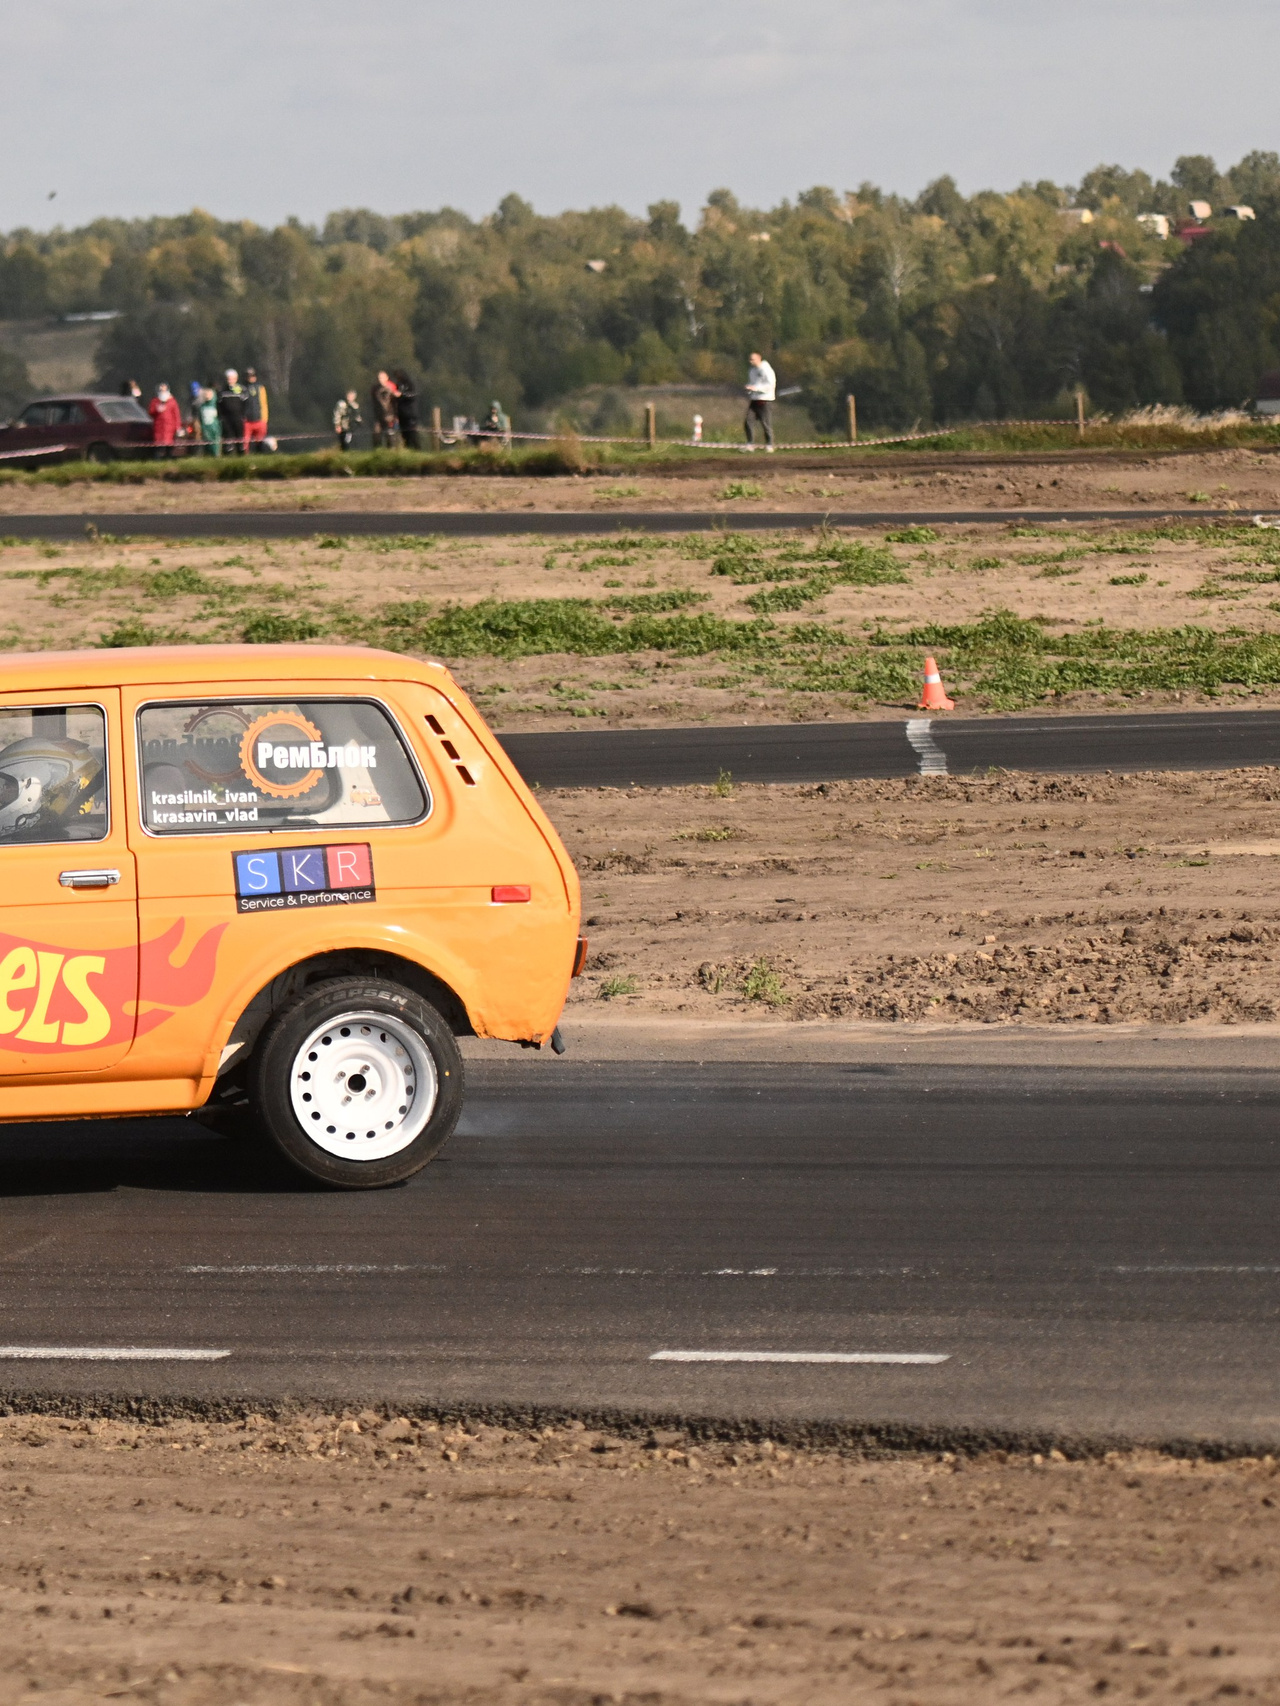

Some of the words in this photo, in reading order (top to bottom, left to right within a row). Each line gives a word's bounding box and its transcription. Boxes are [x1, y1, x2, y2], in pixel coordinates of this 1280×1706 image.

[257, 742, 376, 769] РемБлок
[152, 790, 258, 806] krasilnik_ivan
[153, 808, 258, 824] krasavin_vlad
[247, 850, 360, 890] SKR
[241, 899, 284, 910] Service
[287, 895, 297, 905] &
[300, 890, 371, 904] Perfomance
